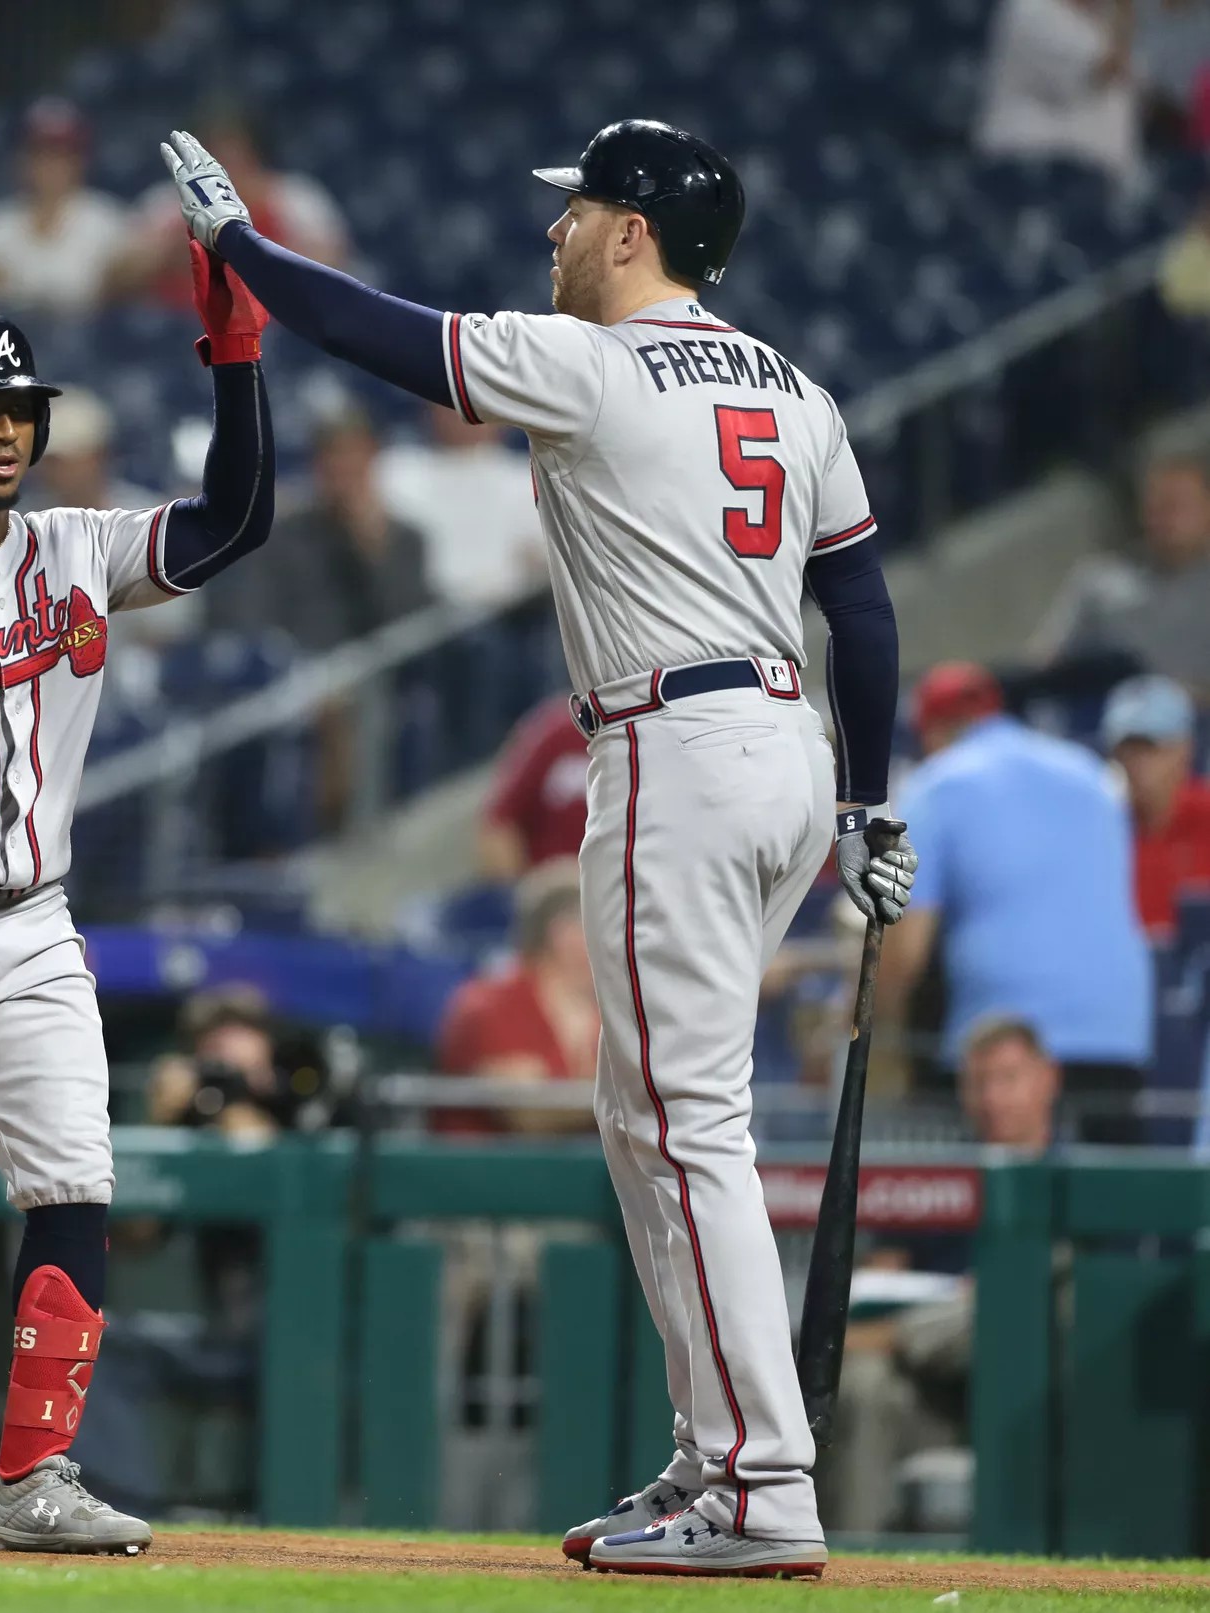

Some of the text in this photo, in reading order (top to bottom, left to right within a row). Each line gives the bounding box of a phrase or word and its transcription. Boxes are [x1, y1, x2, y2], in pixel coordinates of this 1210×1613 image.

[636, 340, 805, 401] FREEMAN
[713, 404, 786, 560] 5
[846, 814, 856, 831] 5
[78, 1332, 89, 1352] 1
[41, 1400, 54, 1421] 1
